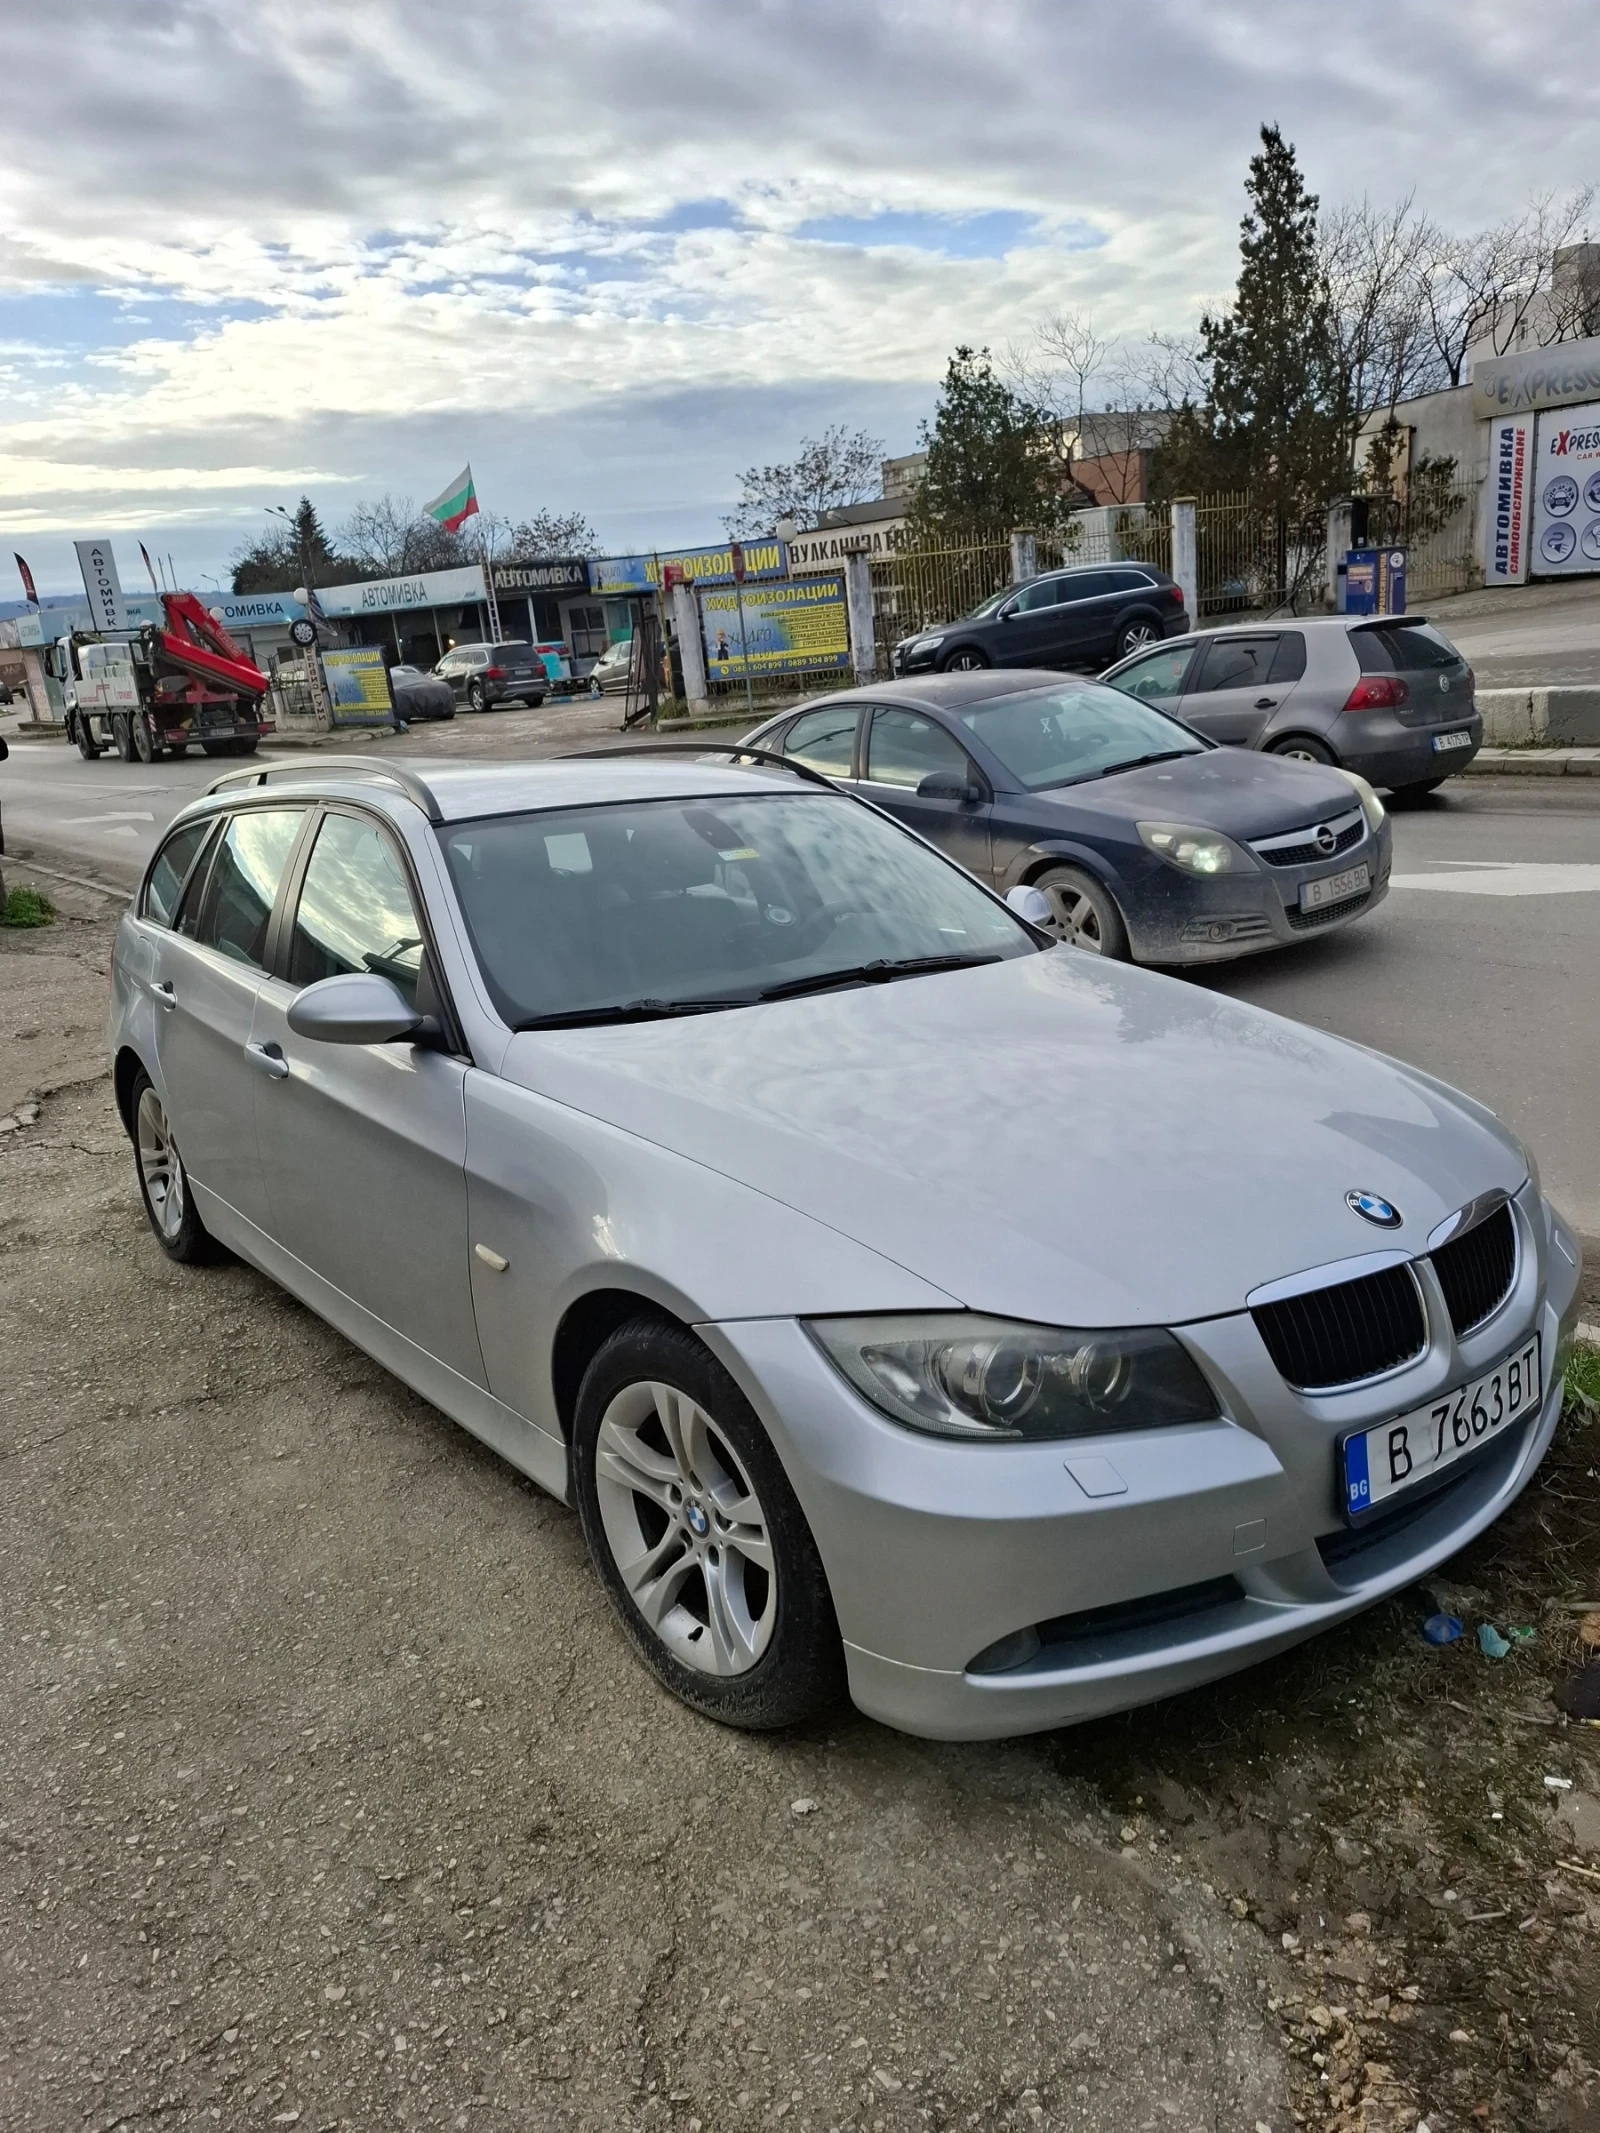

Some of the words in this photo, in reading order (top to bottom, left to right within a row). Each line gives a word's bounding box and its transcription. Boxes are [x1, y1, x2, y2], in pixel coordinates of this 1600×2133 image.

[1550, 430, 1600, 456] EXPRES
[1495, 427, 1514, 575] АВТОМИВКА
[1510, 428, 1525, 574] САМООБСЛУЖВАНЕ
[790, 528, 910, 564] ВУЛКАНИЗАТО
[495, 566, 583, 588] АВТОМИВКА
[644, 545, 780, 583] ХОИЗОЛЦИИ
[91, 548, 117, 630] АВТОМИВК
[362, 581, 428, 608] АВТОМИВКА
[208, 602, 284, 618] ОМИВКА
[753, 663, 767, 671] 604
[768, 661, 782, 669] 899
[788, 658, 806, 667] 0889
[809, 656, 822, 665] 304
[824, 654, 838, 663] 899
[305, 648, 319, 690] СЕРВИЗ
[313, 693, 327, 721] ГУМИ
[1438, 738, 1446, 749] B
[1313, 884, 1322, 902] B
[1389, 1426, 1413, 1484] B
[1350, 1480, 1368, 1500] BG
